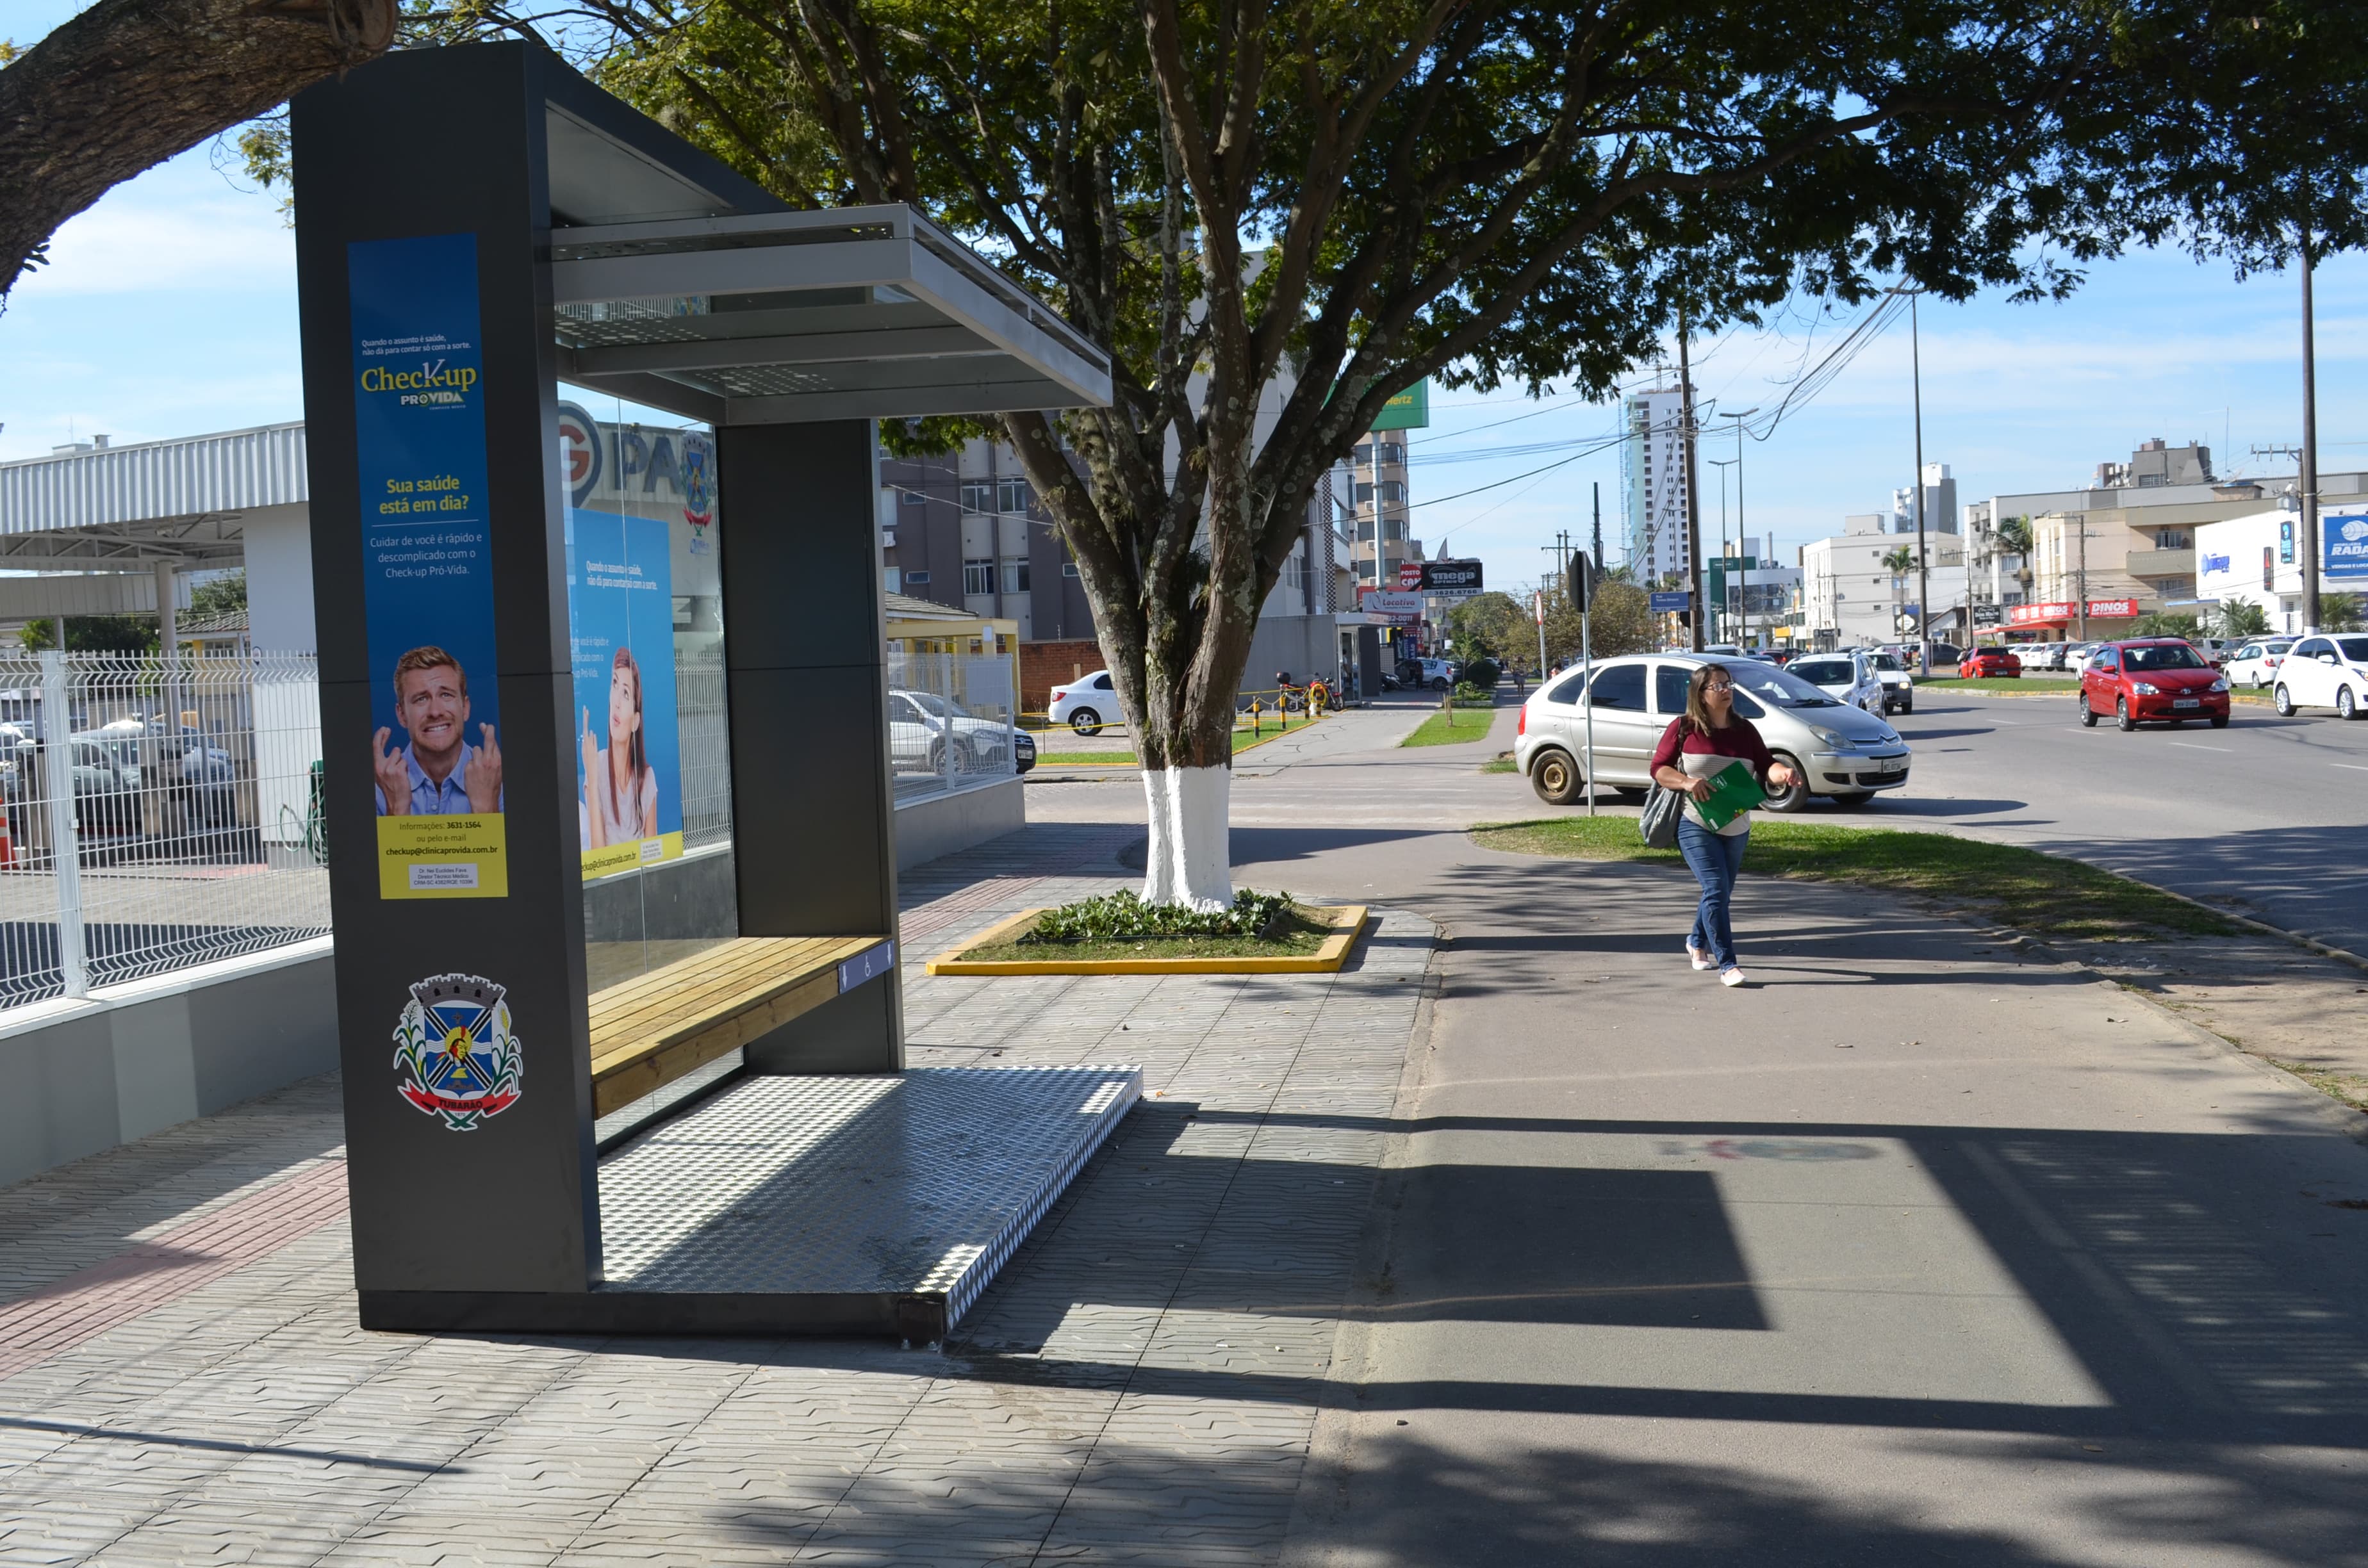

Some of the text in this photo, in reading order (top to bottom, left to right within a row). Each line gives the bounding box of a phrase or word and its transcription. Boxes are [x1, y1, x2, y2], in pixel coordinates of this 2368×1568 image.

[362, 339, 387, 348] Quando
[394, 336, 420, 345] assunto
[425, 334, 447, 343] saúde,
[401, 345, 422, 354] contar
[452, 341, 472, 349] sorte.
[361, 359, 477, 392] Check-up
[400, 392, 465, 406] PROVIDA
[386, 474, 461, 494] Sua saúde
[379, 494, 470, 515] está em dia?
[370, 532, 482, 548] Cuidar de você é rápido e
[378, 549, 477, 563] descomplicado com o
[386, 564, 471, 578] Check-up Pró-Vida.
[1431, 571, 1476, 584] mega
[2091, 602, 2129, 612] DINOS
[399, 821, 482, 831] Informações: 3631-1564
[427, 835, 443, 843] pelo
[386, 845, 498, 856] checkup@clinicaprovida.com.br
[438, 1098, 483, 1110] TUBARÃO
